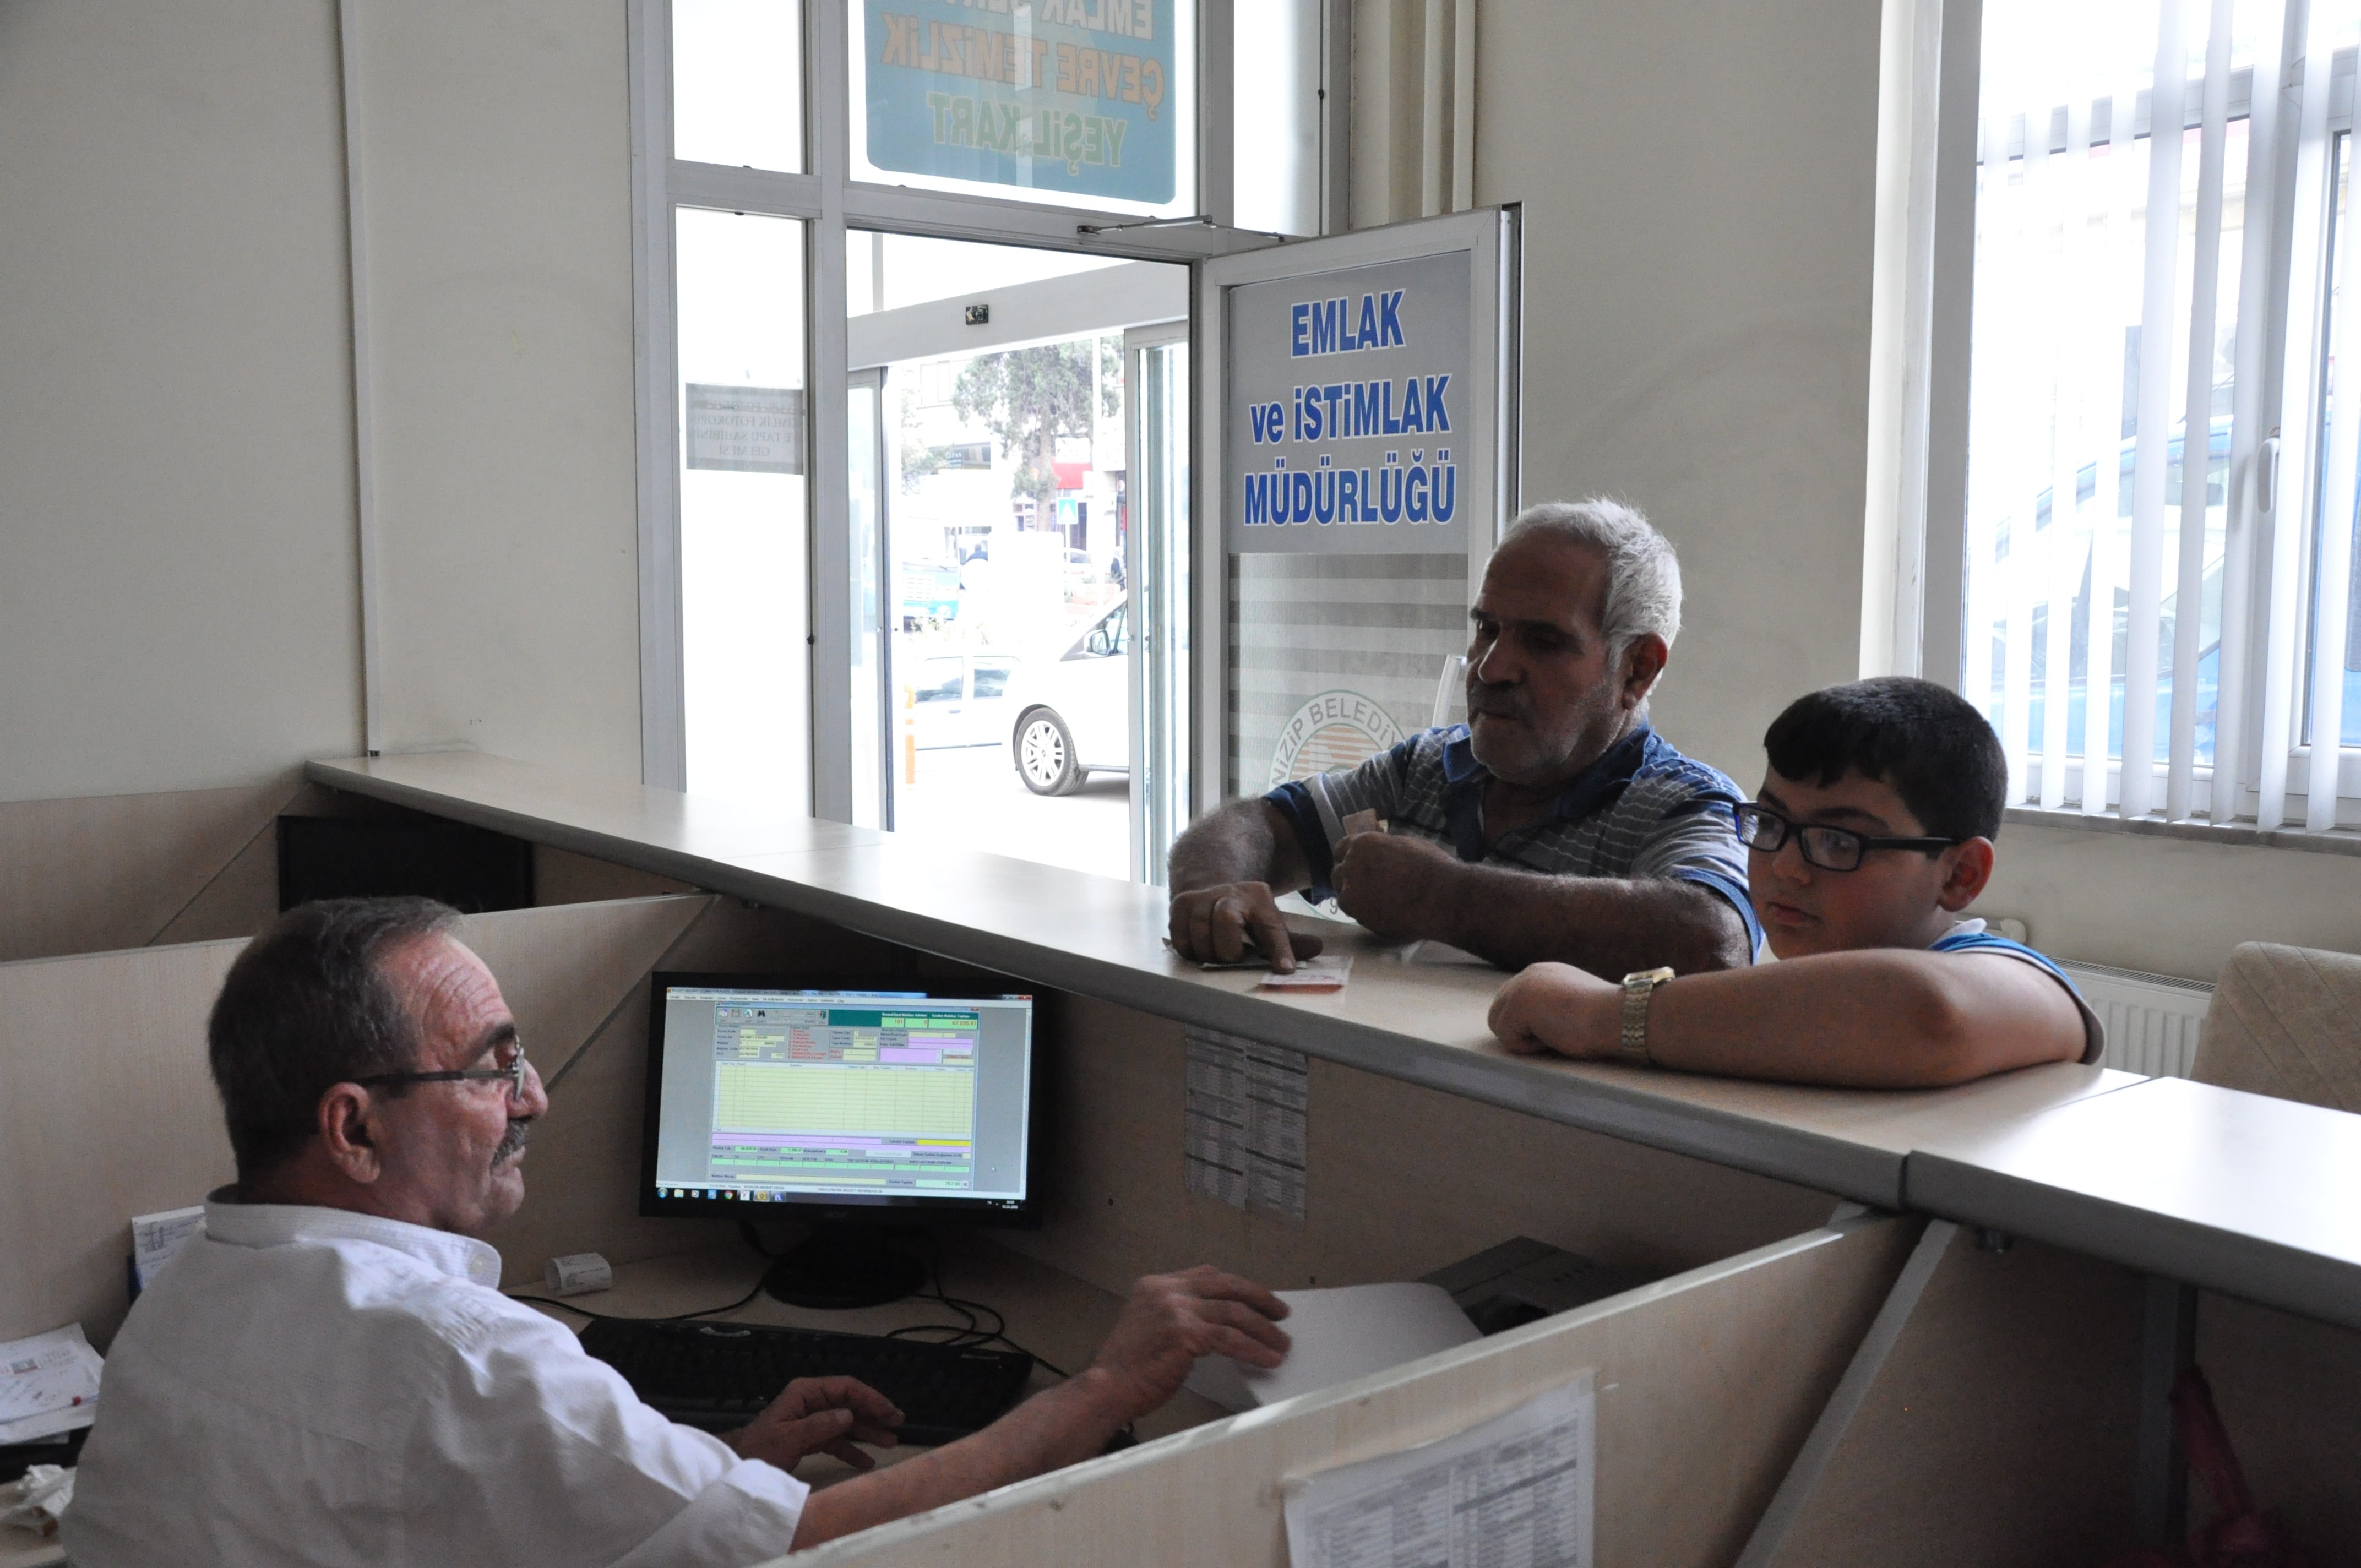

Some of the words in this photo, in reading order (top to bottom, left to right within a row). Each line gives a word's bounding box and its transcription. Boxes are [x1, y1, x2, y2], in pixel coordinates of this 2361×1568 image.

[1291, 288, 1407, 359] EMLAK
[1249, 401, 1285, 445] ve
[1243, 448, 1457, 527] MÜDÜRLÜĞÜ
